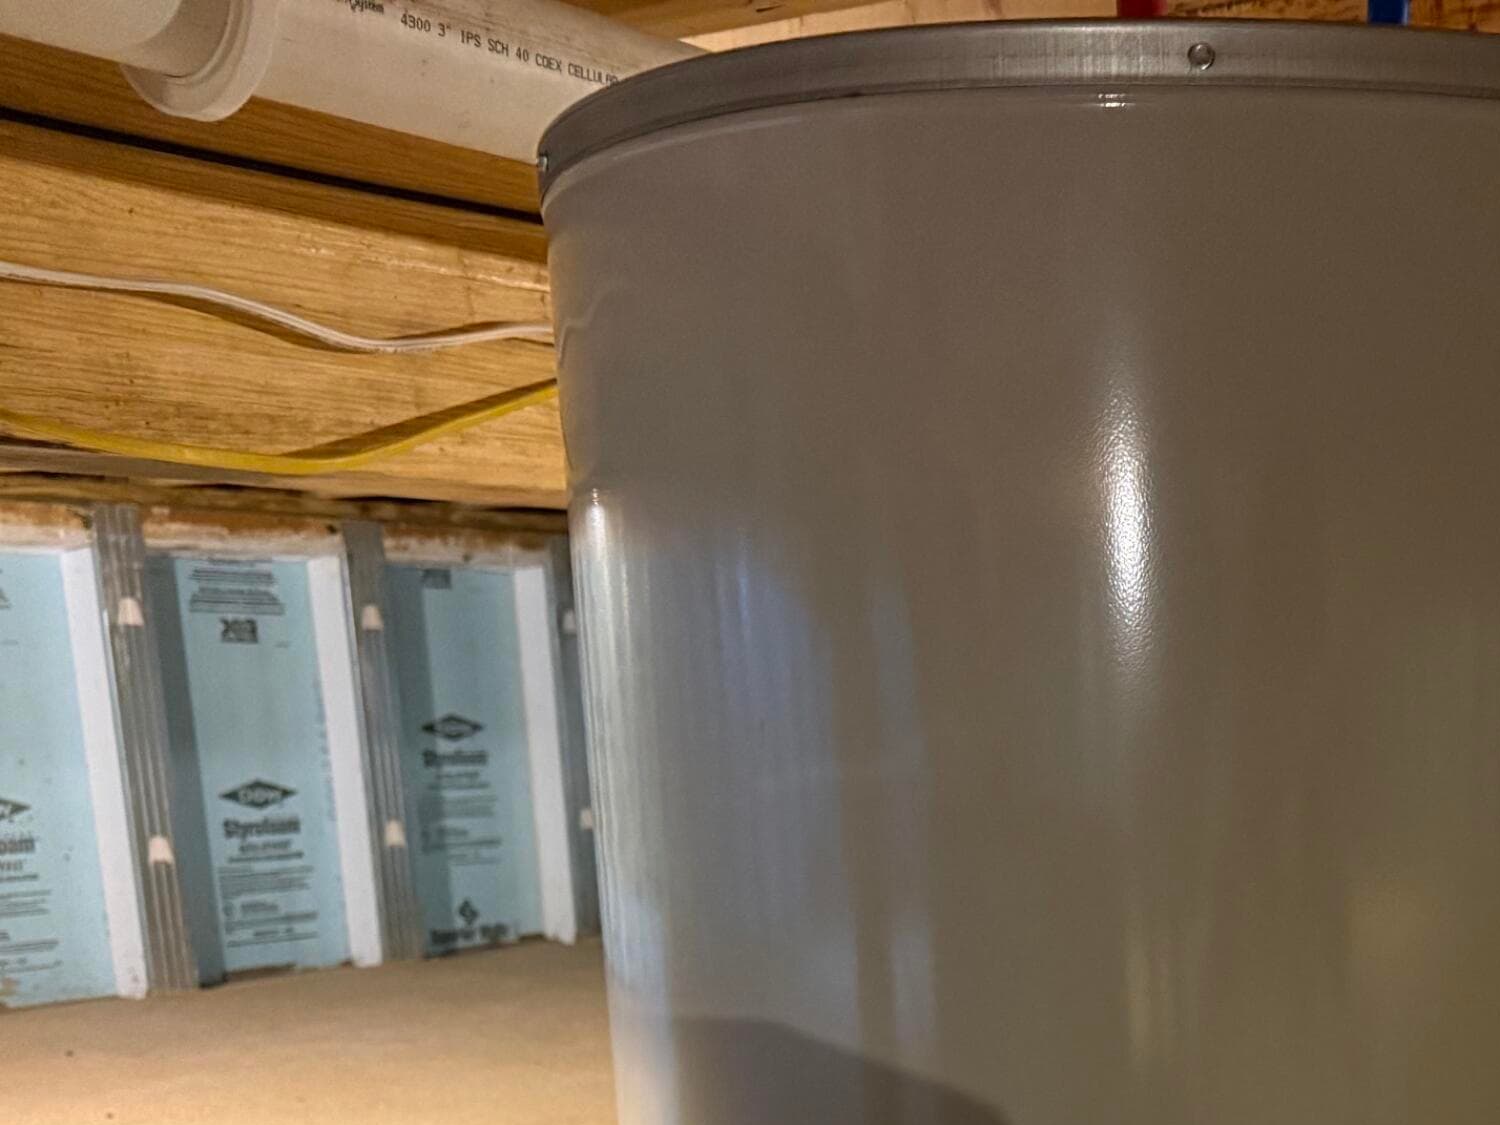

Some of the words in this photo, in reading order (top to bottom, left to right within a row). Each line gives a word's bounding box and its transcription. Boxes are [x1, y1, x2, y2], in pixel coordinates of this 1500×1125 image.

[400, 13, 431, 32] 4300
[460, 30, 481, 48] IPS
[487, 39, 509, 57] SCH
[516, 46, 529, 62] 40
[535, 53, 562, 73] COEX
